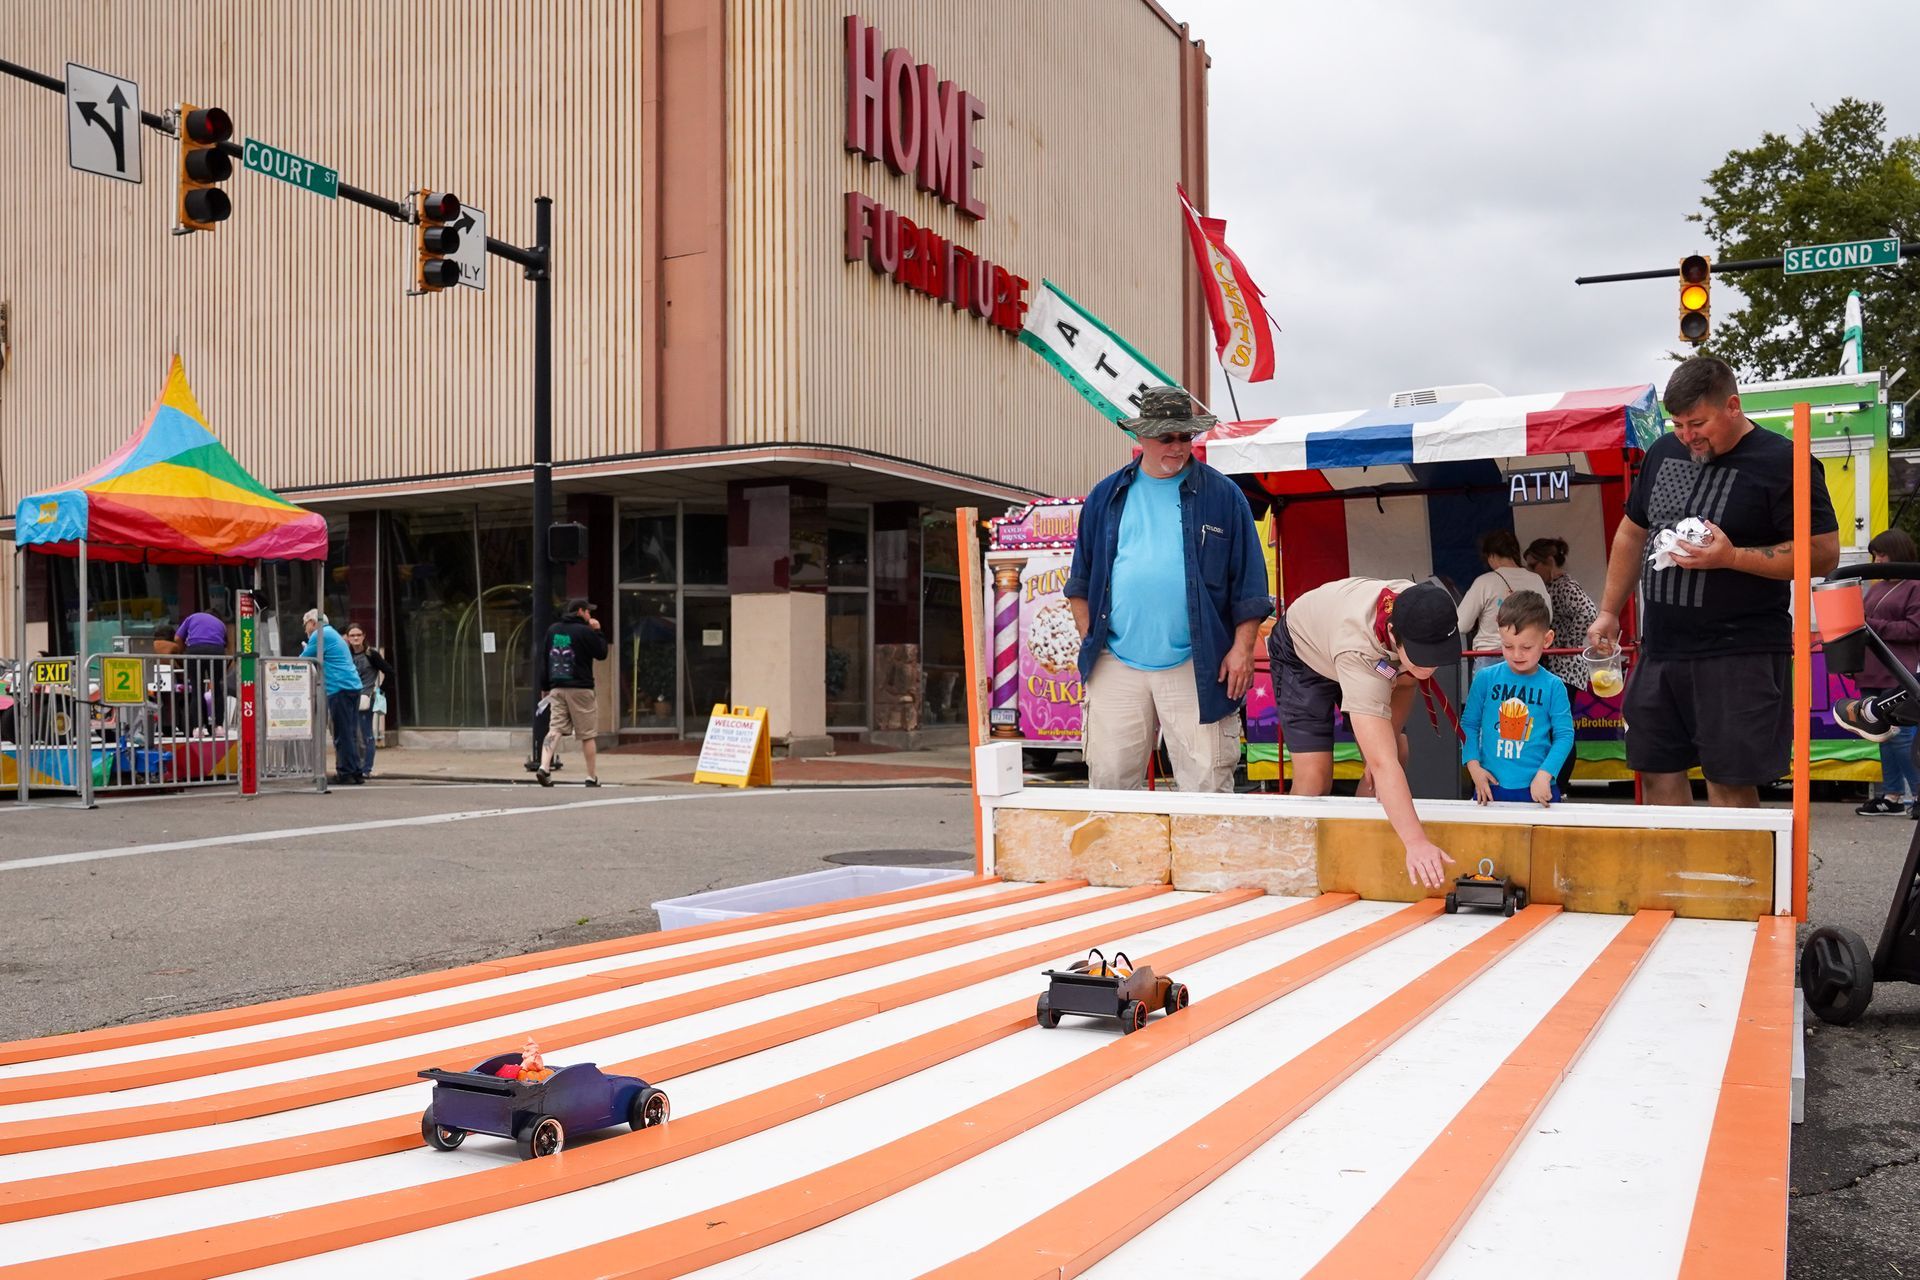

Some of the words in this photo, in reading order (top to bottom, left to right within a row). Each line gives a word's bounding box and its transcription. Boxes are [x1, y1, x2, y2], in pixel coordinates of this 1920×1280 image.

[845, 14, 985, 220] HOME
[246, 143, 315, 187] COURT
[324, 171, 336, 185] ST
[844, 191, 1029, 335] FURNITURE
[1787, 244, 1873, 270] SECOND
[1883, 241, 1896, 252] ST
[459, 262, 480, 281] NLY
[1510, 470, 1569, 502] ATM
[1032, 509, 1073, 538] Funnel
[242, 628, 252, 654] YES
[37, 663, 68, 682] EXIT
[116, 671, 130, 691] 2
[1491, 684, 1543, 706] SMALL
[244, 701, 253, 717] NO
[715, 719, 754, 729] WELCOME
[1496, 740, 1525, 759] FRY
